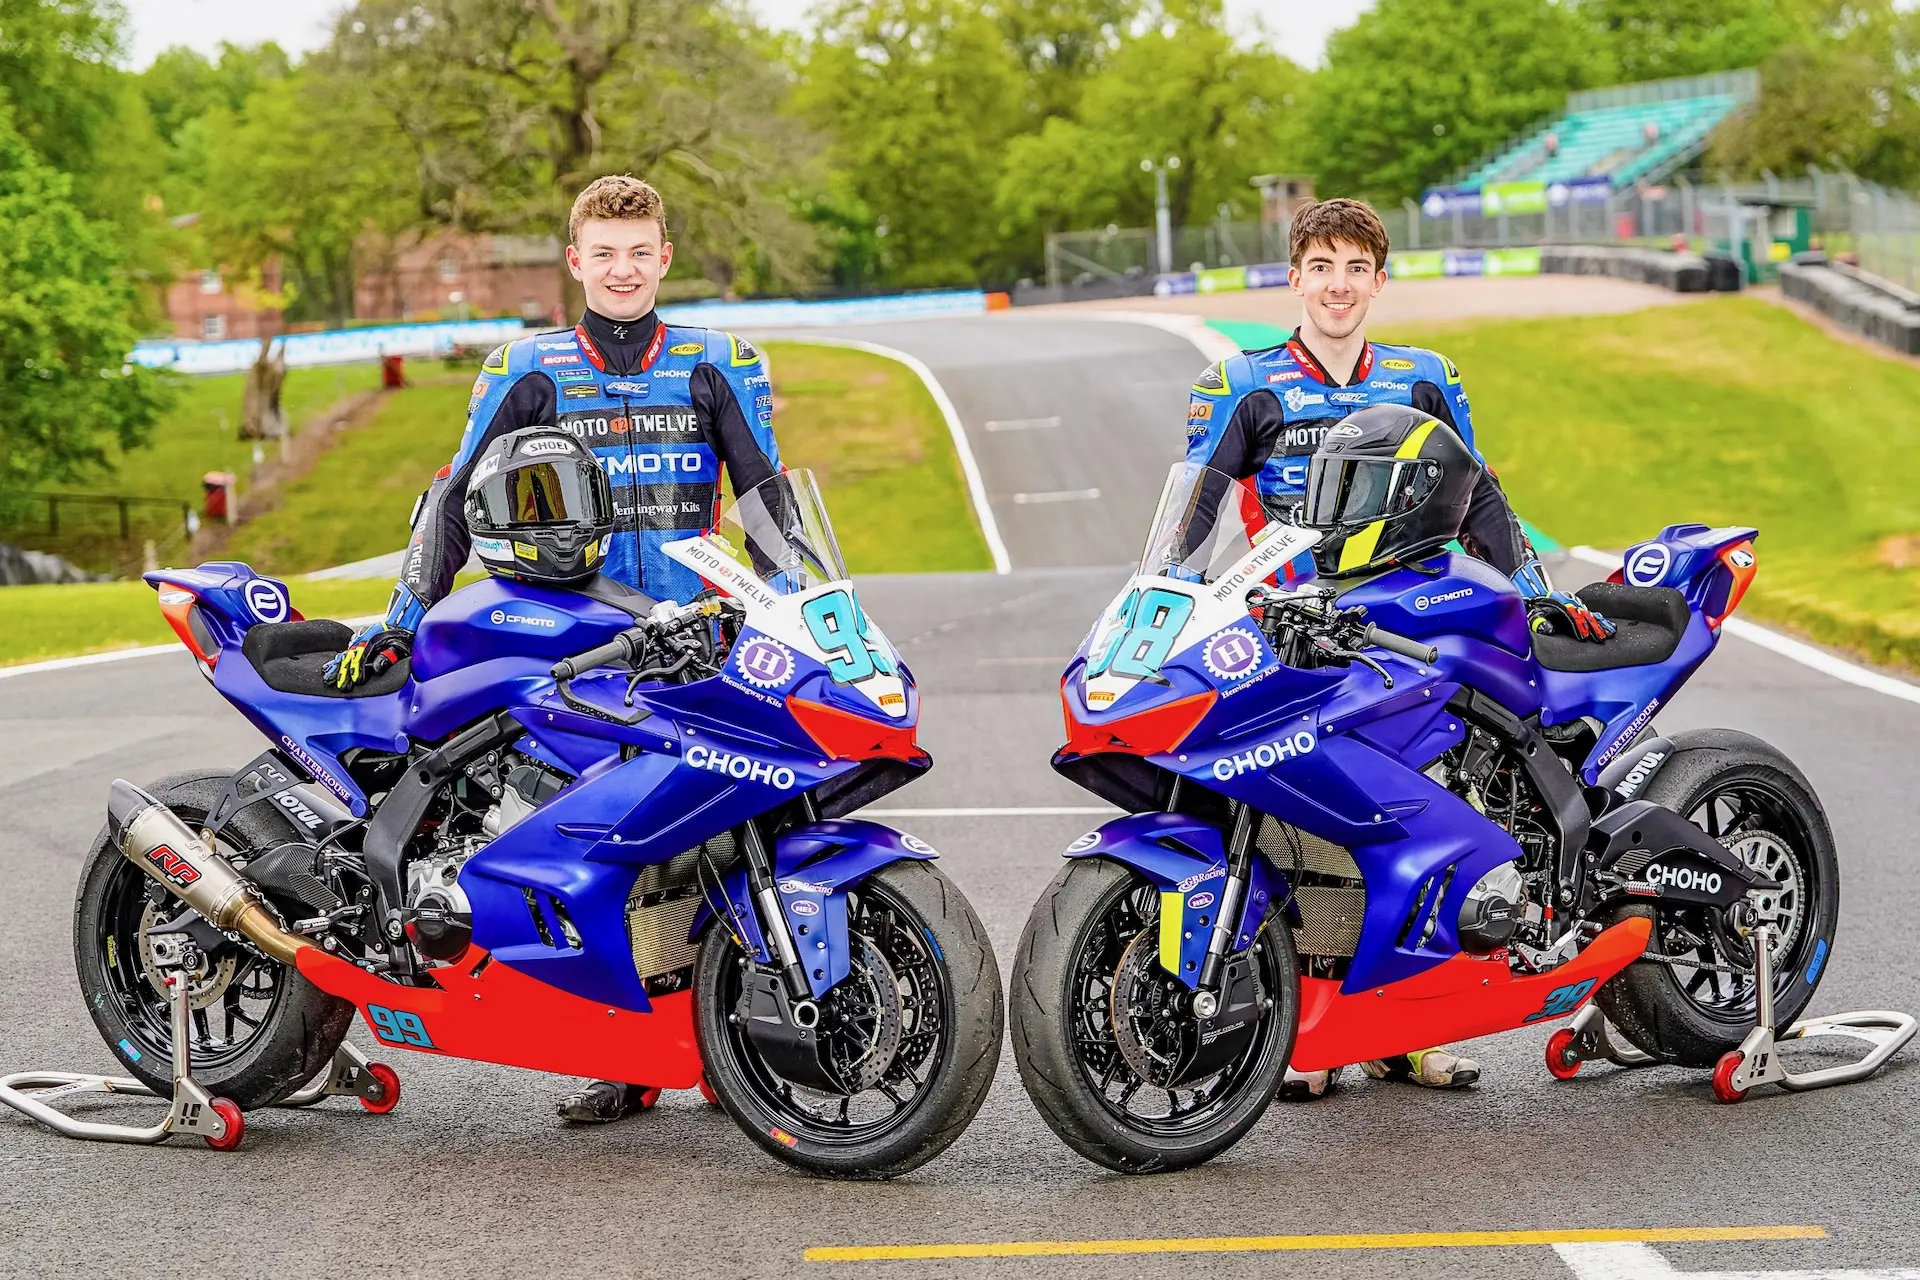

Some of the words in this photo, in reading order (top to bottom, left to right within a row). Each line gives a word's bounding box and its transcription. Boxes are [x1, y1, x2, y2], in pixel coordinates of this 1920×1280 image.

[543, 355, 579, 365] MOTUL
[577, 334, 599, 360] RST
[647, 333, 662, 362] RST
[1293, 348, 1317, 372] RST
[653, 370, 691, 378] CHOHO
[1269, 371, 1304, 383] MOTUL
[1370, 380, 1408, 391] CHOHO
[632, 415, 698, 433] TWELVE
[530, 441, 569, 452] SHOEI
[598, 452, 702, 475] MOTO
[681, 501, 700, 512] Kits
[408, 544, 423, 584] TWELVE
[686, 545, 719, 569] MOTO
[732, 573, 776, 610] TWELVE
[1213, 574, 1246, 602] MOTO
[1252, 533, 1296, 566] TWELVE
[1430, 587, 1473, 605] CFMOTO
[506, 614, 556, 628] CFMOTO
[748, 644, 782, 677] H
[1214, 638, 1250, 669] H
[722, 675, 766, 702] Hemingway
[766, 695, 782, 709] Kits
[1221, 670, 1264, 699] Hemingway
[1262, 664, 1280, 680] Kits
[1597, 697, 1660, 767] CHARTERHOUSE
[281, 735, 351, 801] CHARTERHOUSE
[686, 745, 796, 790] CHOHO
[1212, 731, 1316, 781] CHOHO
[1614, 752, 1666, 798] MOTUL
[149, 845, 202, 883] RP
[1184, 867, 1226, 887] GBRacing
[1645, 863, 1722, 894] CHOHO
[367, 1003, 436, 1049] 99
